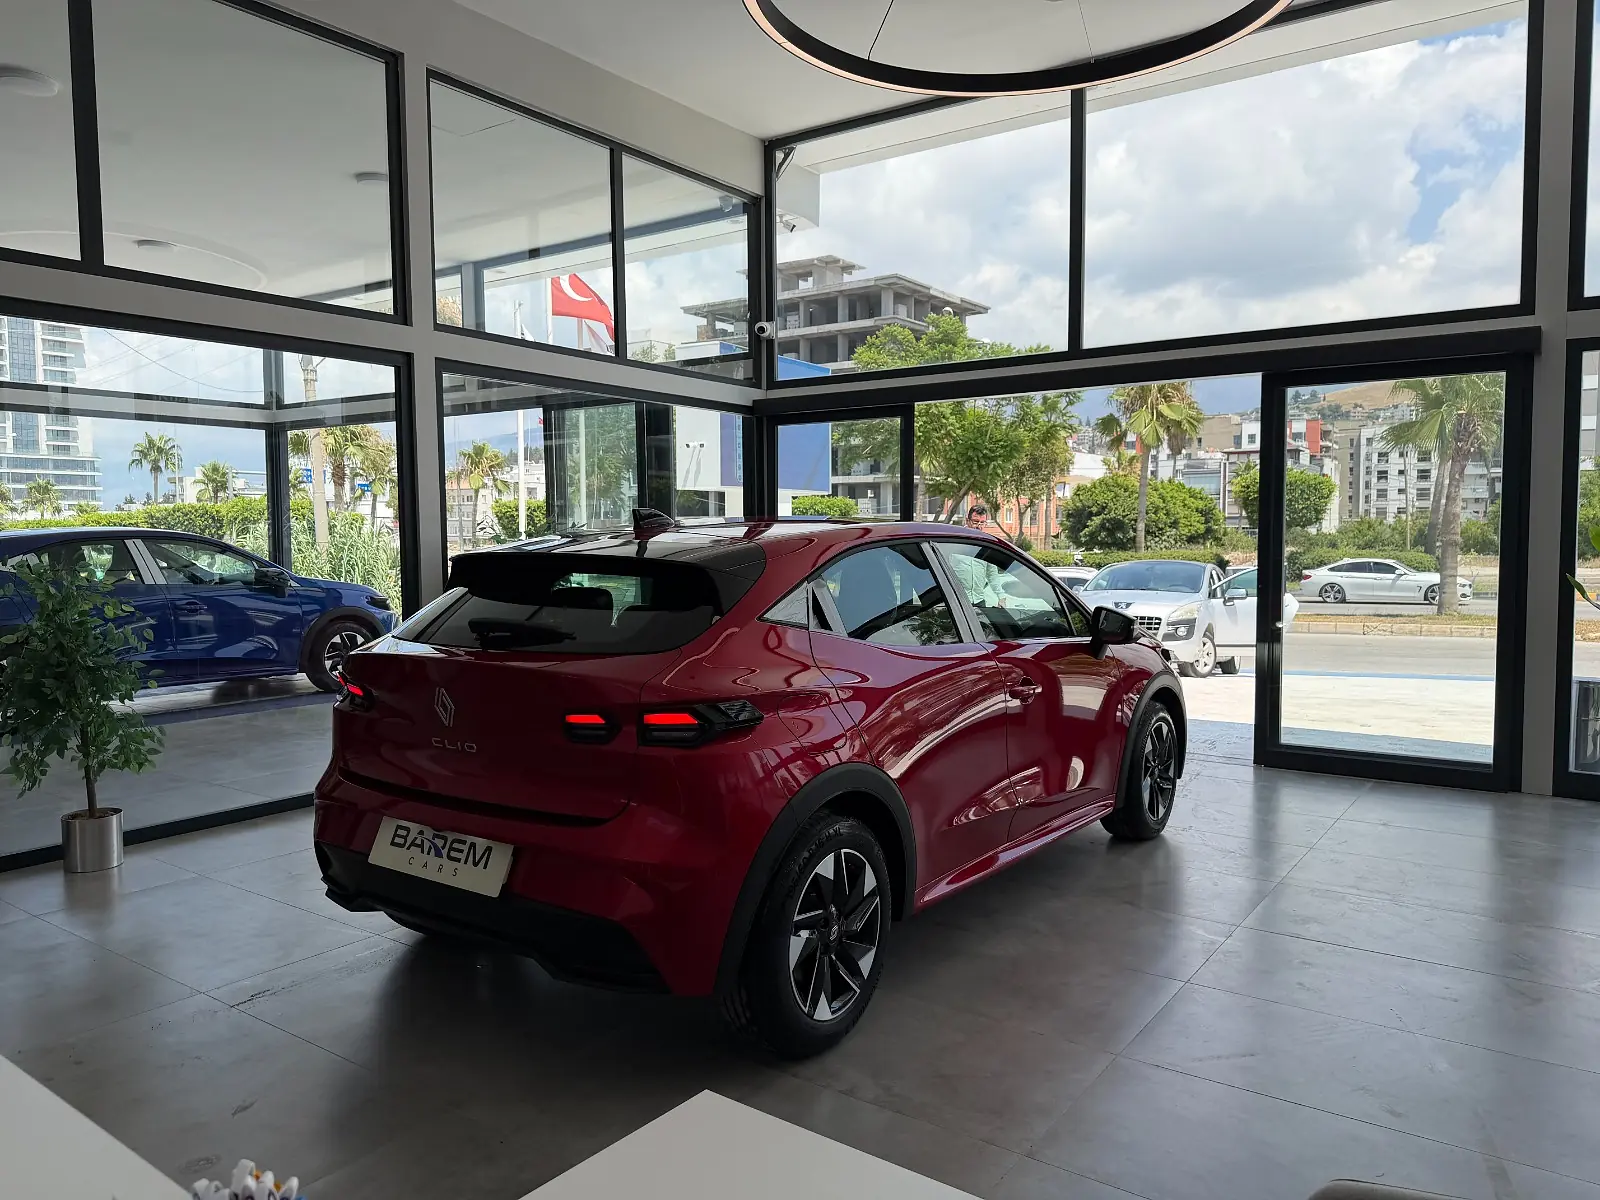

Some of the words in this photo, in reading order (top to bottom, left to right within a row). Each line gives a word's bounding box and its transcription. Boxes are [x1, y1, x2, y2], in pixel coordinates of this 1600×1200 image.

[431, 737, 477, 752] CLIO
[389, 824, 494, 870] BAREM
[408, 856, 459, 877] CARS
